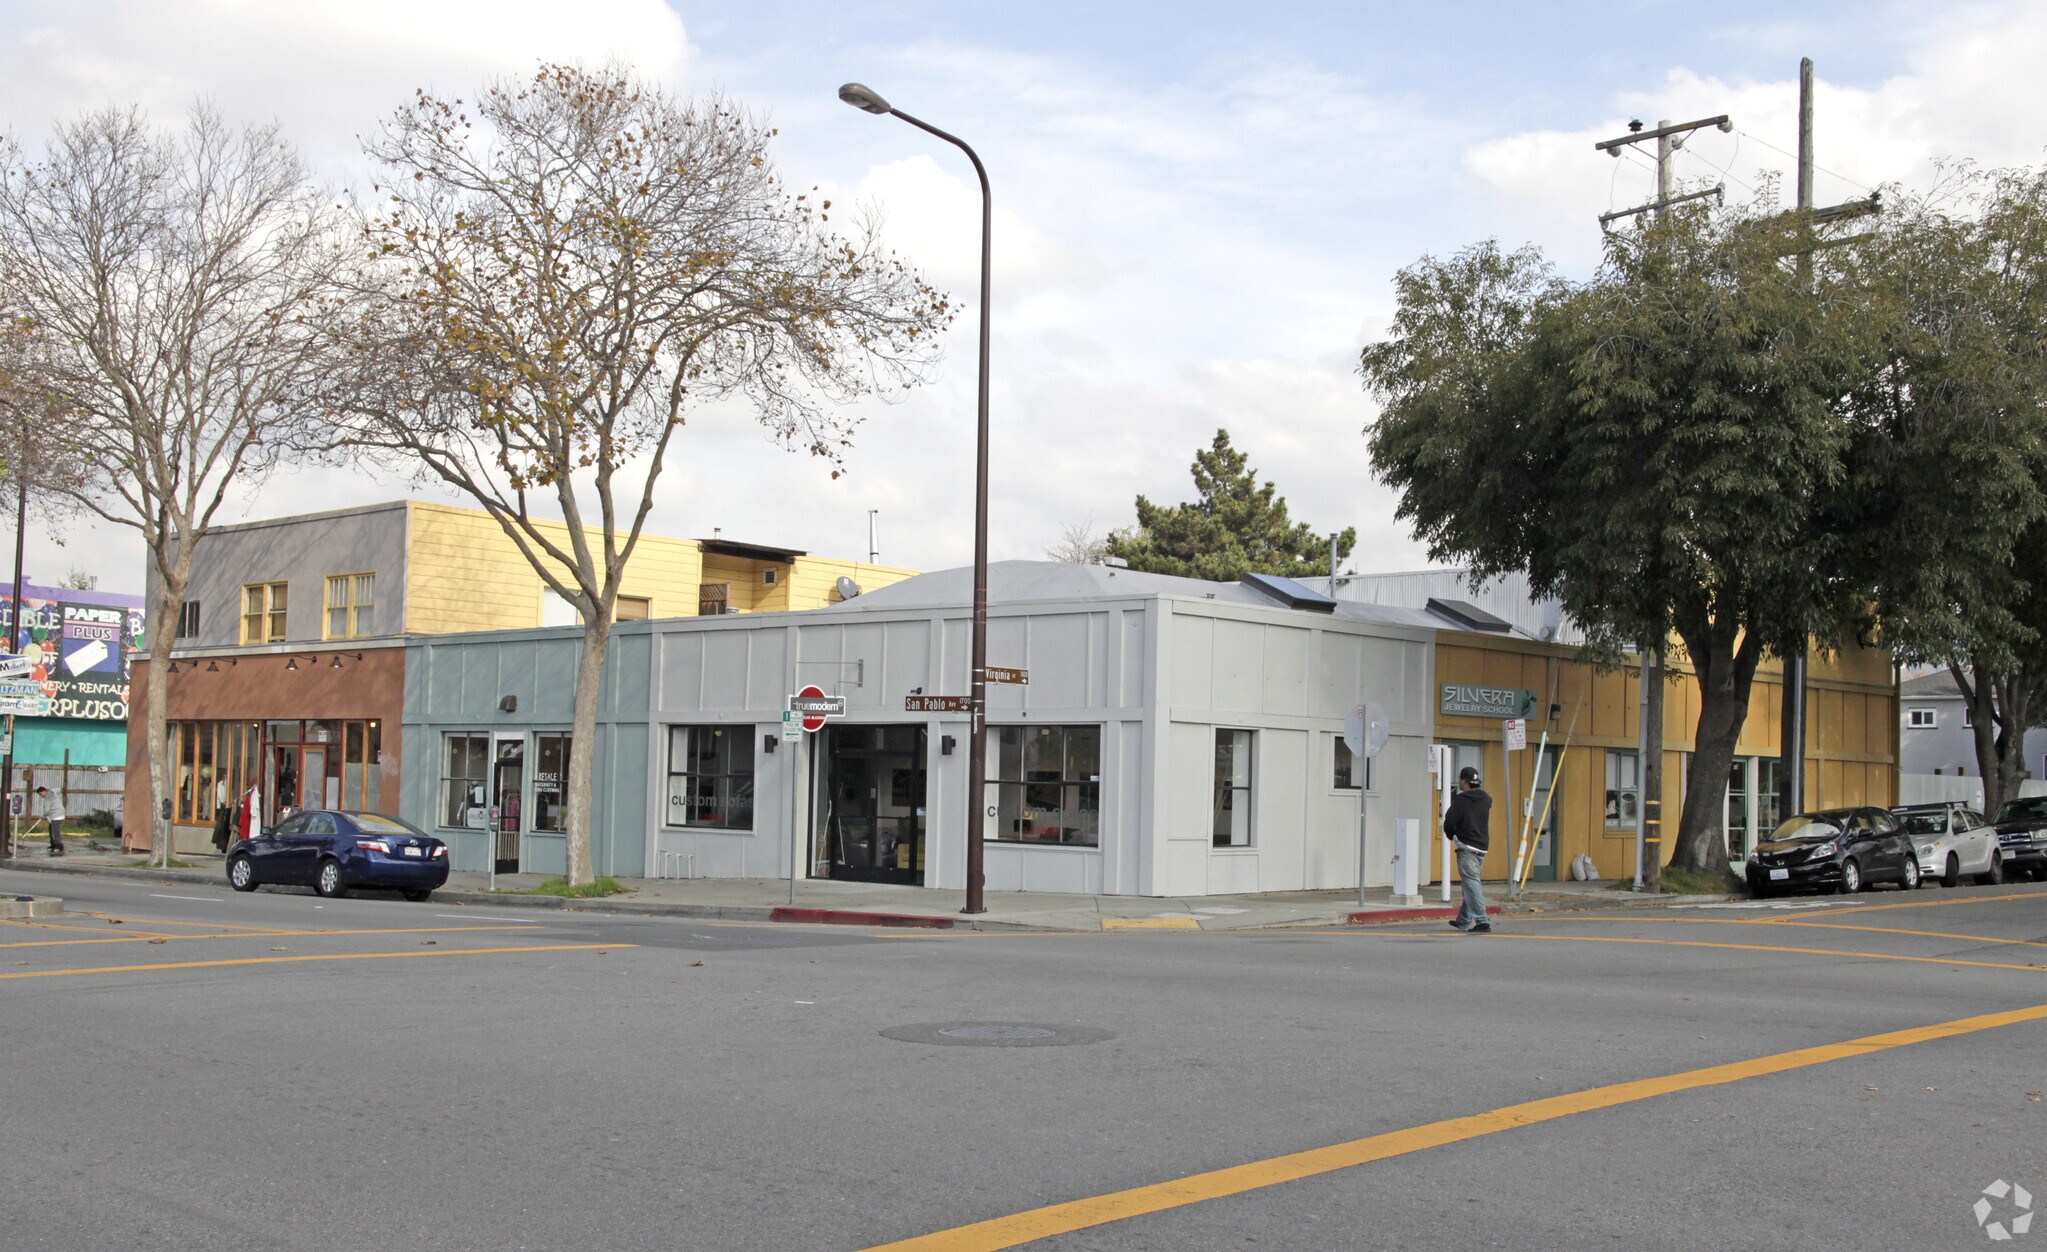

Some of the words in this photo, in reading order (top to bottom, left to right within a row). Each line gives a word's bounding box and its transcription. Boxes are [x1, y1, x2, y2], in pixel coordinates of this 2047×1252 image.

[64, 606, 121, 623] PAPER
[73, 625, 111, 640] PLUS
[985, 668, 1011, 682] Virginia
[1444, 686, 1515, 706] SILVERA
[793, 701, 839, 711] truemodern
[906, 698, 921, 710] San
[924, 698, 946, 710] Pablo
[960, 697, 971, 705] 1700
[1444, 703, 1481, 712] JEWELRY
[1483, 705, 1515, 714] SCHOOL
[538, 772, 558, 781] RESALE
[671, 795, 717, 807] custom
